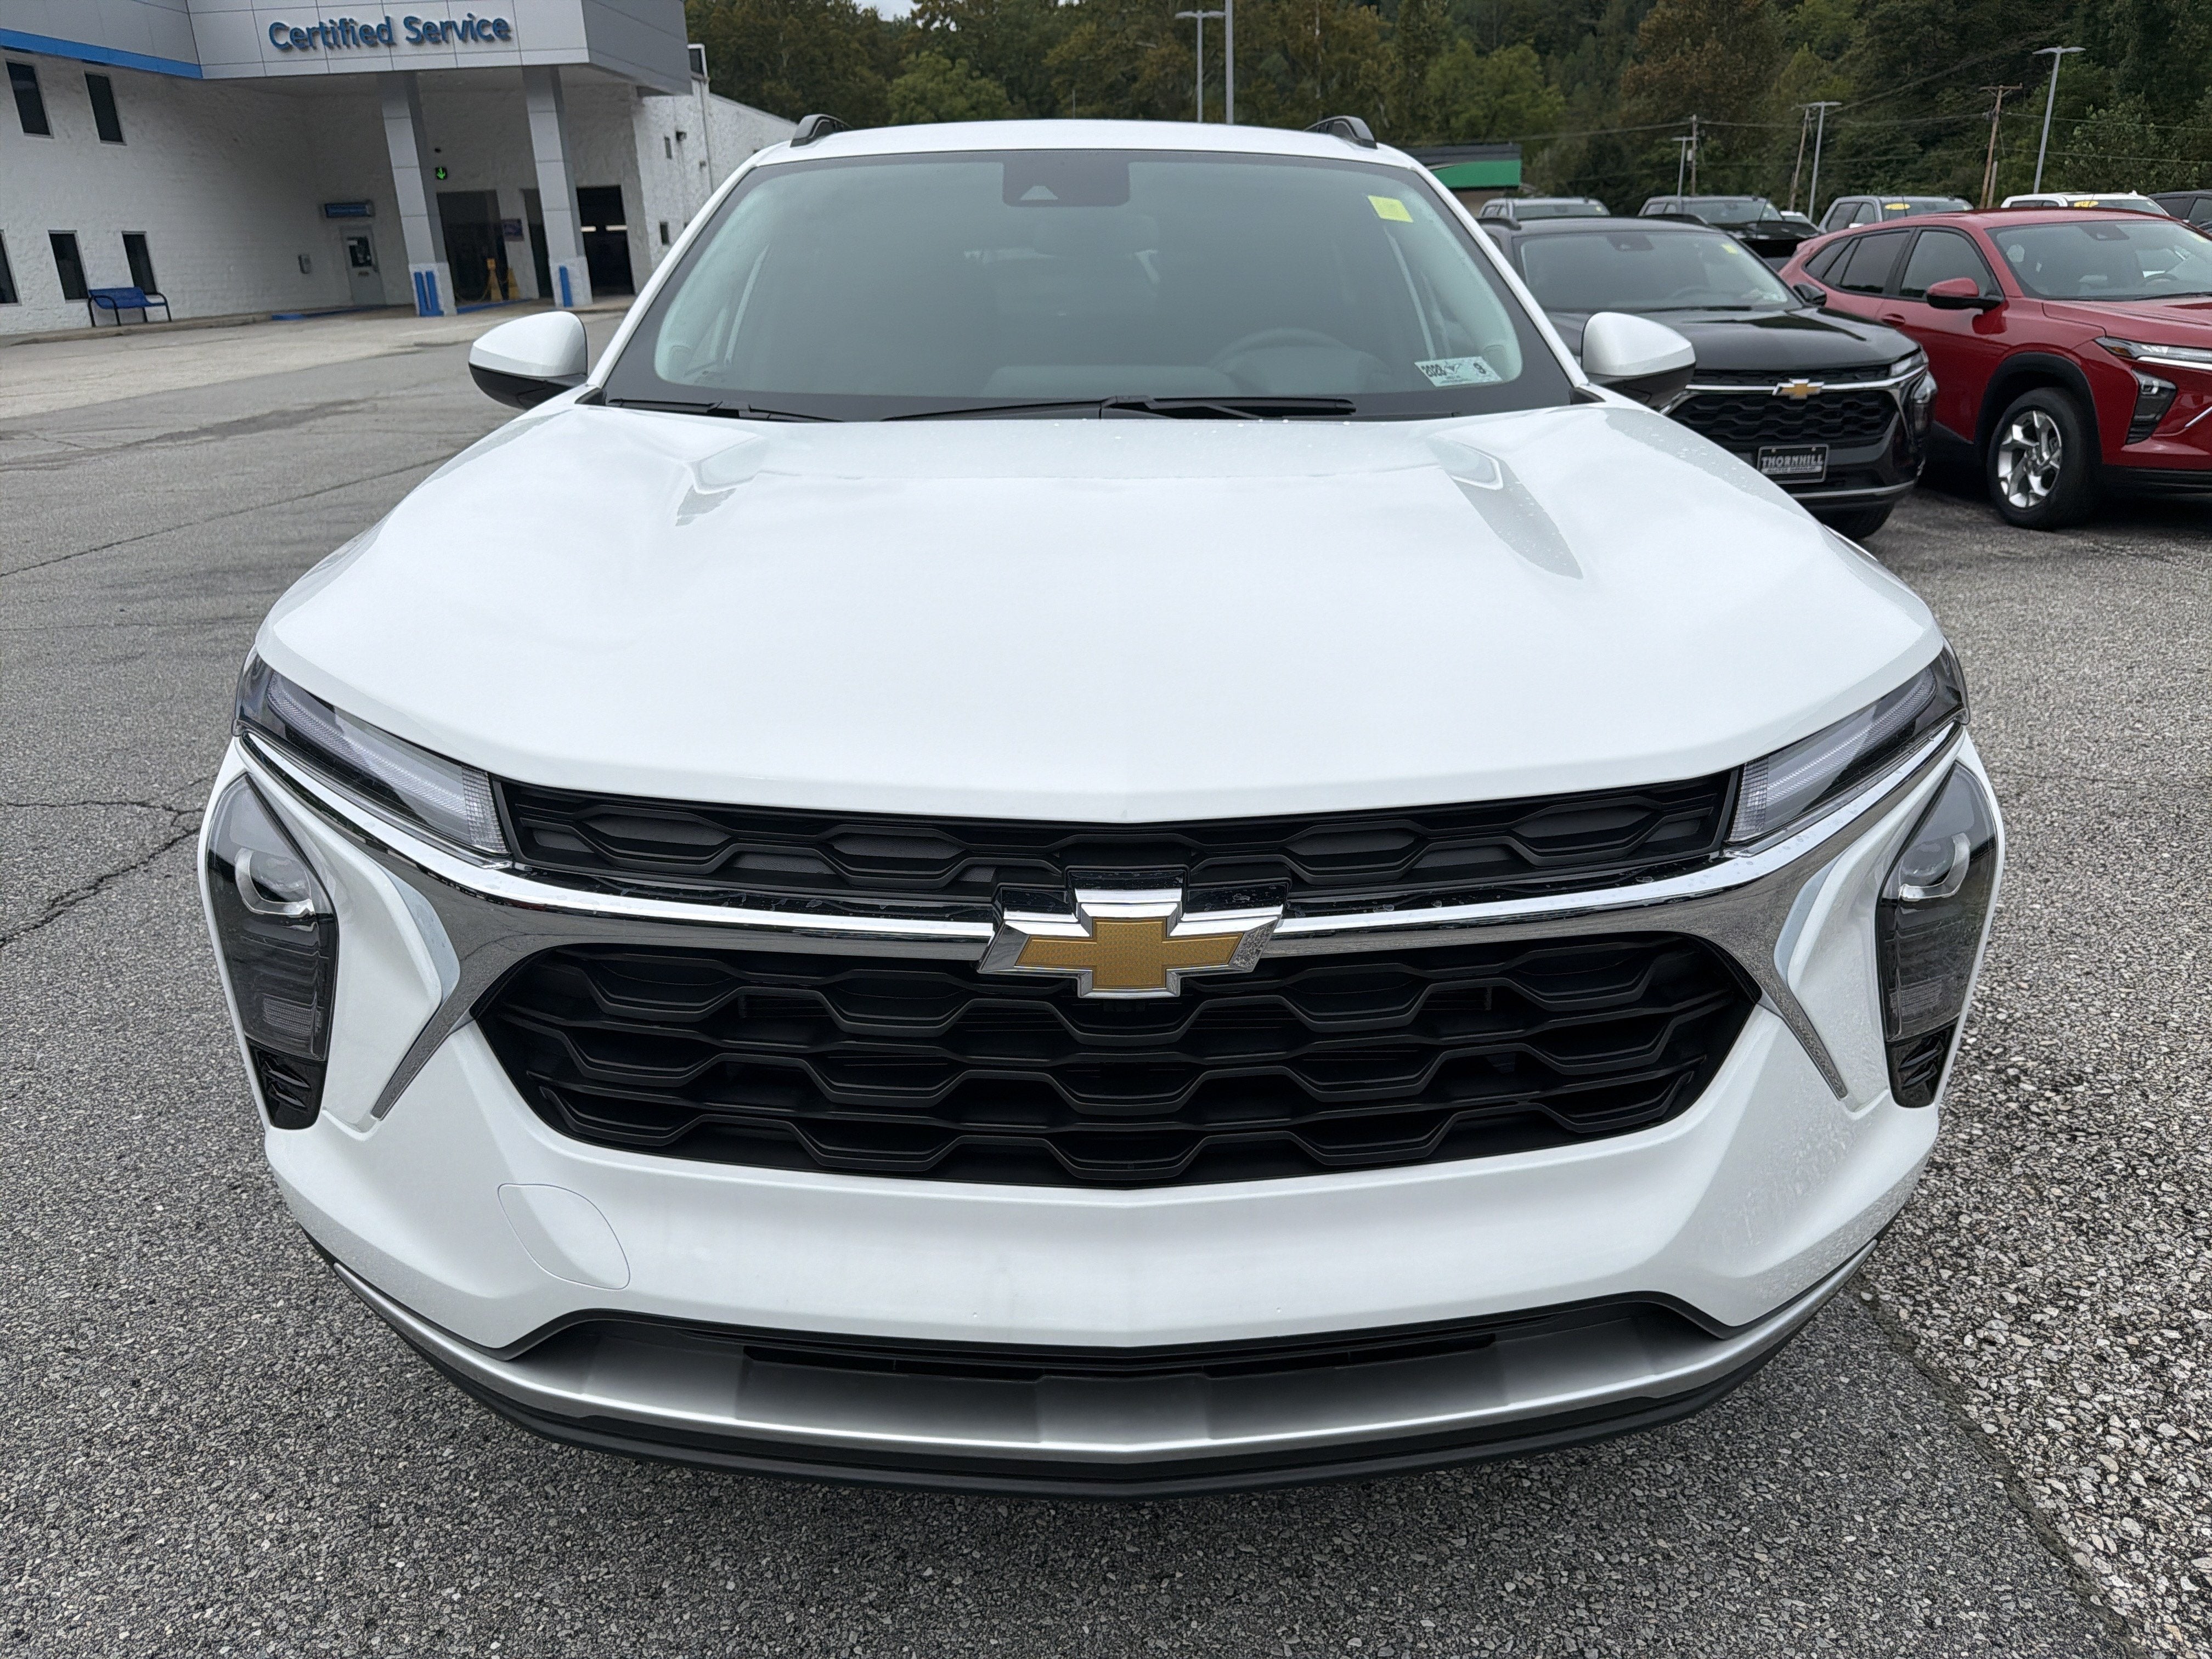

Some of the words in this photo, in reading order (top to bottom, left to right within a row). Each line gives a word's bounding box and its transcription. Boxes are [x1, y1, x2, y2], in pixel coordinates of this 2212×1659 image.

[268, 16, 395, 50] Certified
[403, 13, 511, 45] Service
[1761, 454, 1824, 469] THORNHILL
